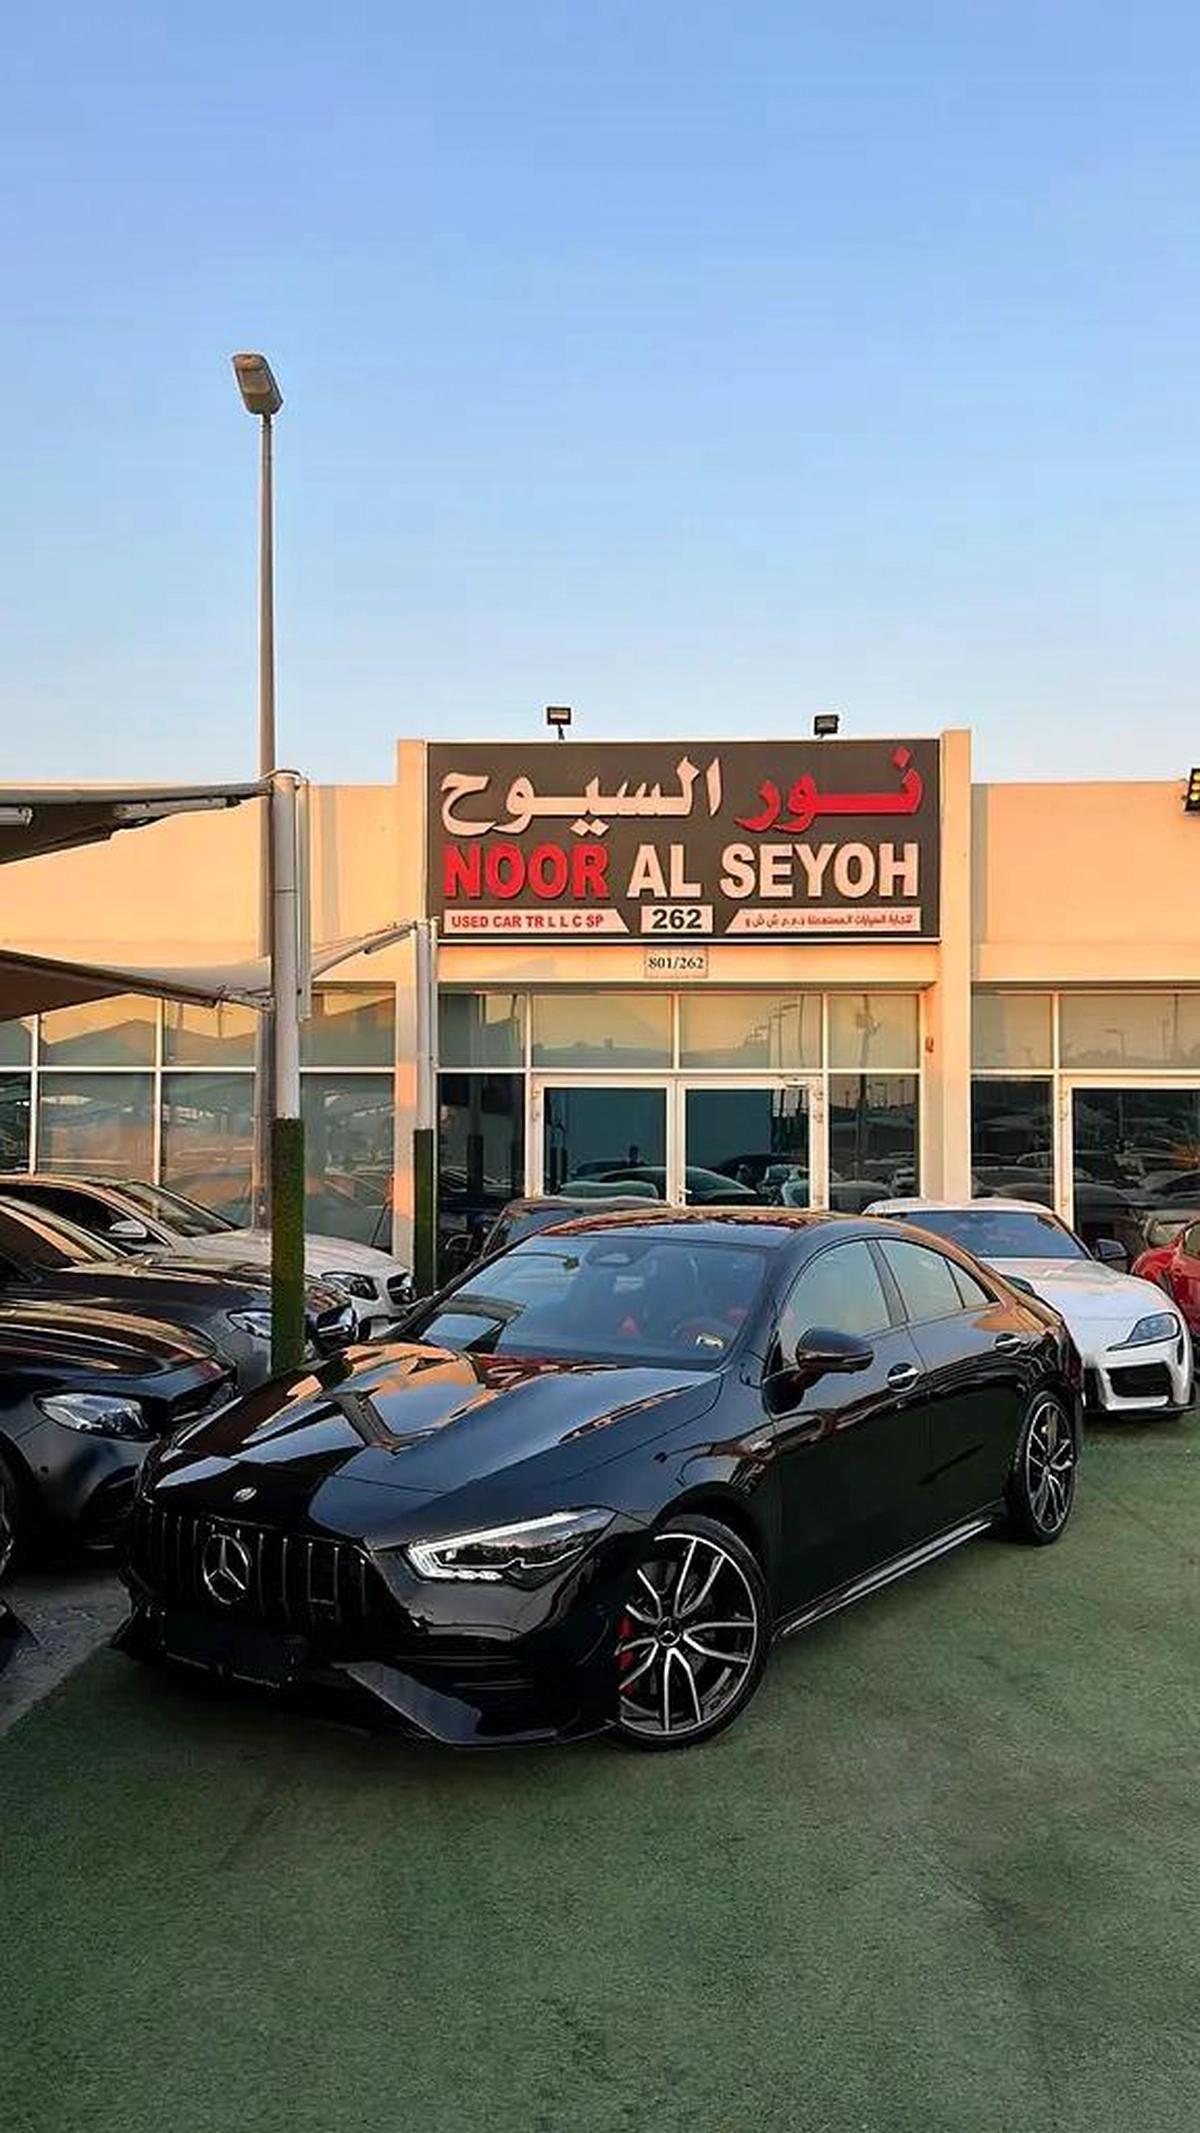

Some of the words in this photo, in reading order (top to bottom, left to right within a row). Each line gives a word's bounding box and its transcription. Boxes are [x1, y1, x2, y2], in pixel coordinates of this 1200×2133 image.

[441, 757, 721, 837] السيوح
[736, 748, 922, 832] نور
[442, 843, 608, 898] NOOR
[627, 844, 701, 898] AL
[719, 842, 918, 899] SEYOH
[451, 916, 488, 928] USED
[493, 916, 521, 928] CAR
[526, 916, 544, 928] TR
[548, 916, 557, 928] L
[560, 916, 569, 928] L
[572, 916, 582, 928] C
[586, 915, 603, 928] SP
[651, 908, 702, 930] 262
[648, 957, 704, 970] 801/262
